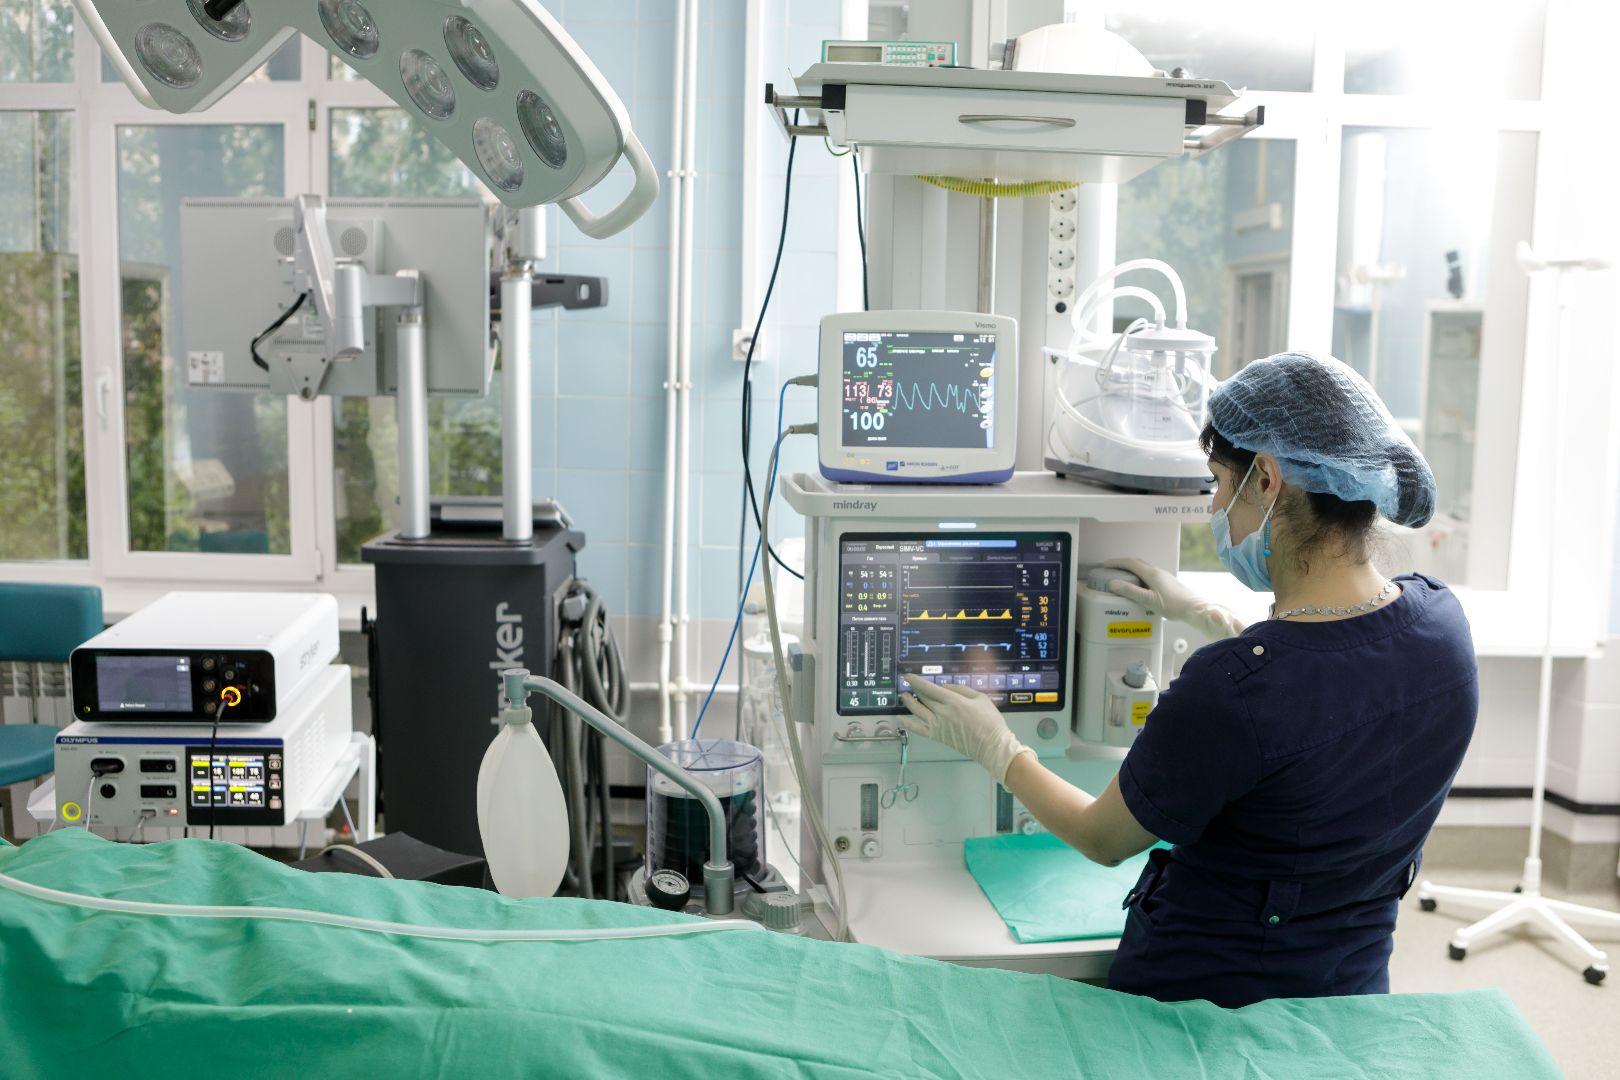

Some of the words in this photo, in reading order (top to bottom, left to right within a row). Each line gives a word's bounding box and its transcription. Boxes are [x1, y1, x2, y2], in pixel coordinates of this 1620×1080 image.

[856, 347, 878, 368] 65
[877, 384, 892, 398] 73
[850, 411, 885, 431] 100
[833, 500, 877, 512] mindray
[1154, 505, 1179, 514] WATO
[860, 570, 868, 578] 54
[879, 570, 887, 578] 54
[858, 592, 868, 600] 0.9
[877, 592, 887, 600] 0.9
[1038, 596, 1049, 605] 30
[849, 697, 859, 706] 45
